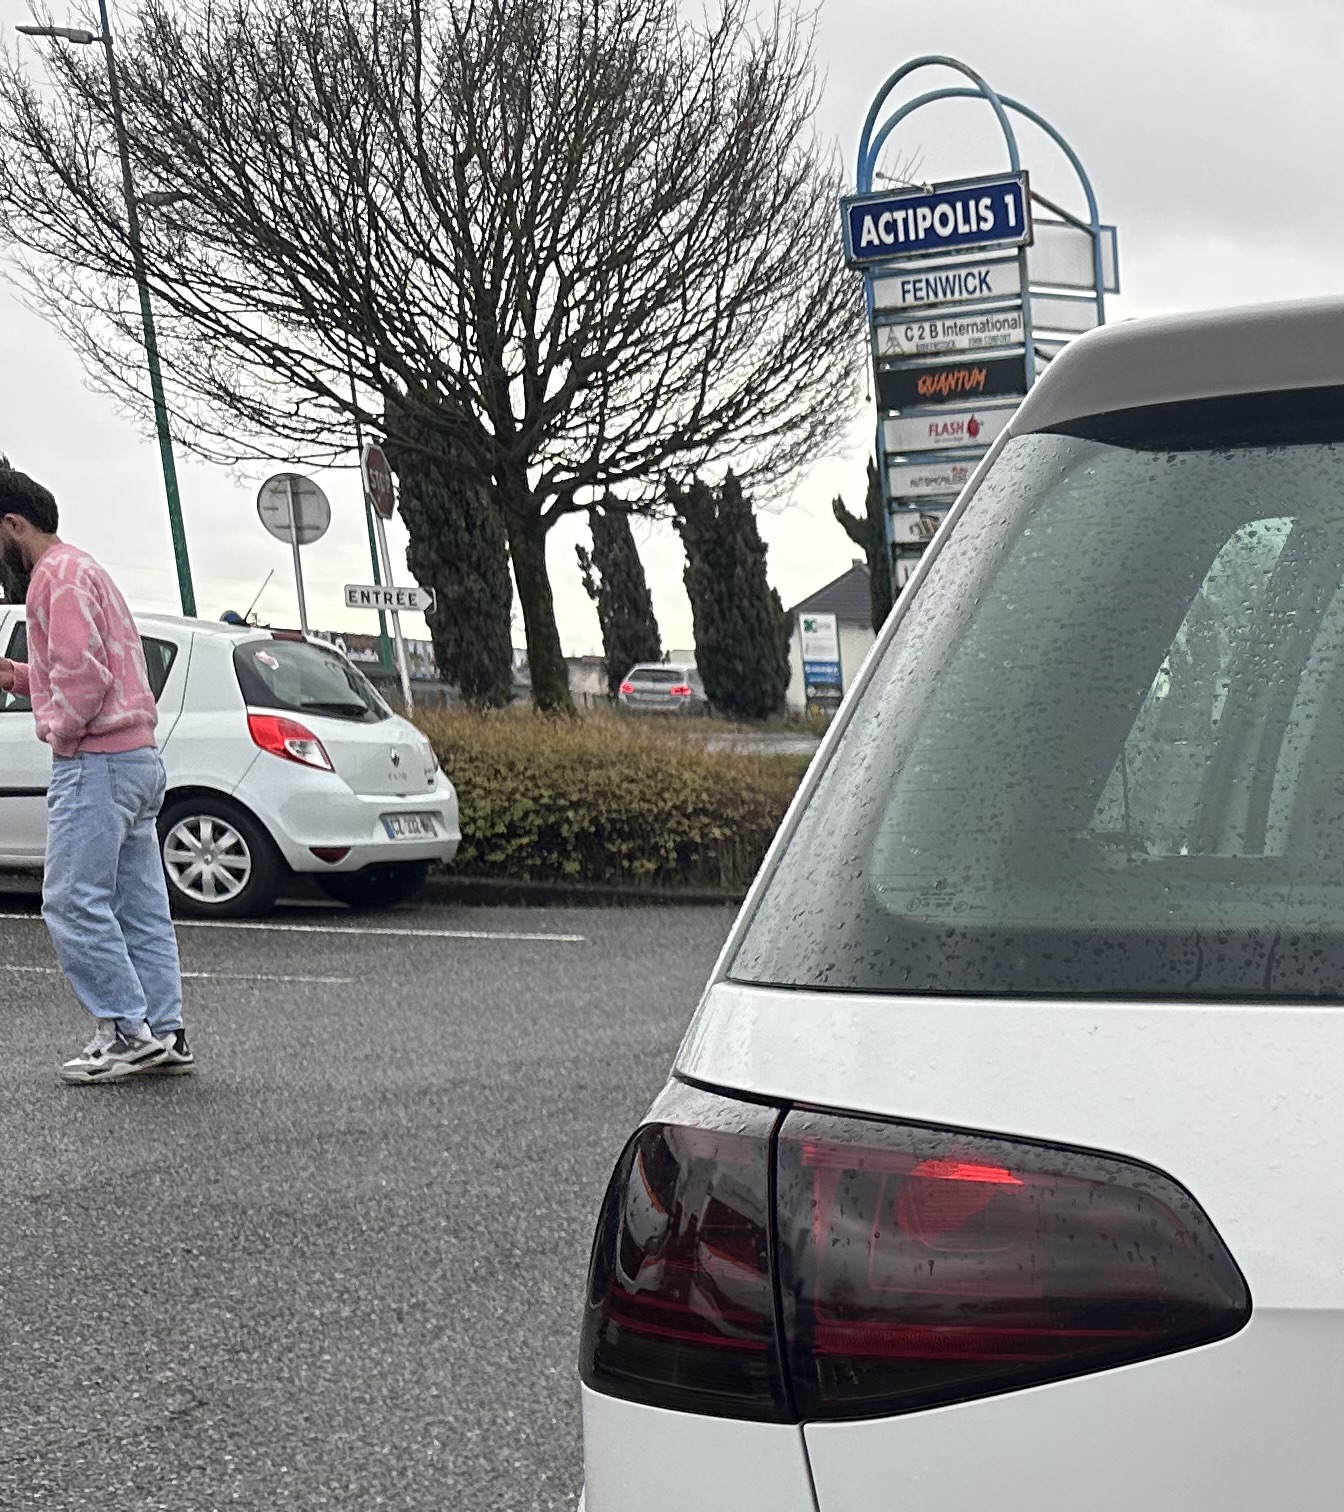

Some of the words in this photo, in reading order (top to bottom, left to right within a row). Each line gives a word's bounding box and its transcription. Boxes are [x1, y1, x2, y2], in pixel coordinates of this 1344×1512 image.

[860, 196, 995, 248] ACTIPOLIS
[1004, 194, 1016, 227] 1
[901, 270, 993, 303] FENWICK
[904, 325, 915, 342] C
[917, 325, 926, 340] 2
[930, 323, 939, 339] B
[942, 314, 1022, 338] International
[917, 368, 987, 397] QUANTUM
[929, 420, 965, 437] FLASH
[348, 588, 419, 607] ENTRÉE
